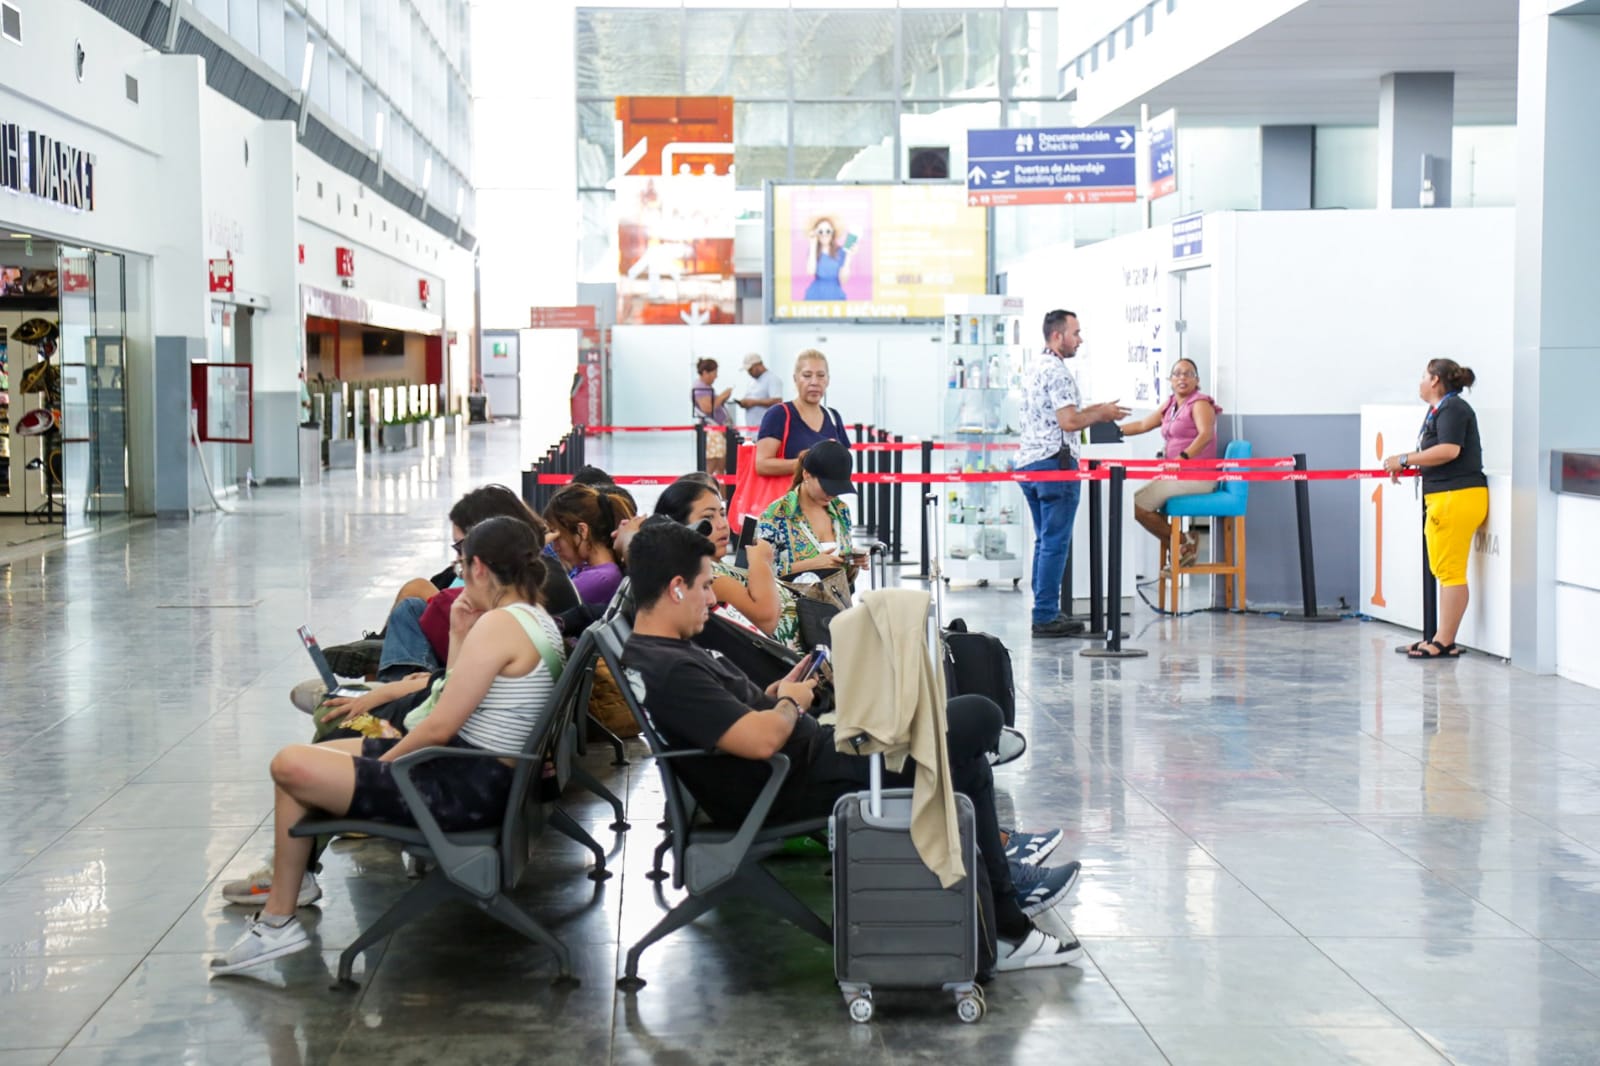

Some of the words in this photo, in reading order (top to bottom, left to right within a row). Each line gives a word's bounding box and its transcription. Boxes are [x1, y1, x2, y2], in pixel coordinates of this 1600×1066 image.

[1038, 131, 1110, 143] Documentación
[1038, 142, 1079, 152] Check-in
[35, 131, 97, 212] MARKET
[1014, 164, 1050, 175] Puertas
[1051, 163, 1062, 174] de
[1063, 162, 1105, 176] Abordaje
[1014, 174, 1055, 186] Boarding
[1056, 172, 1081, 184] Gates
[1474, 531, 1500, 557] OMA
